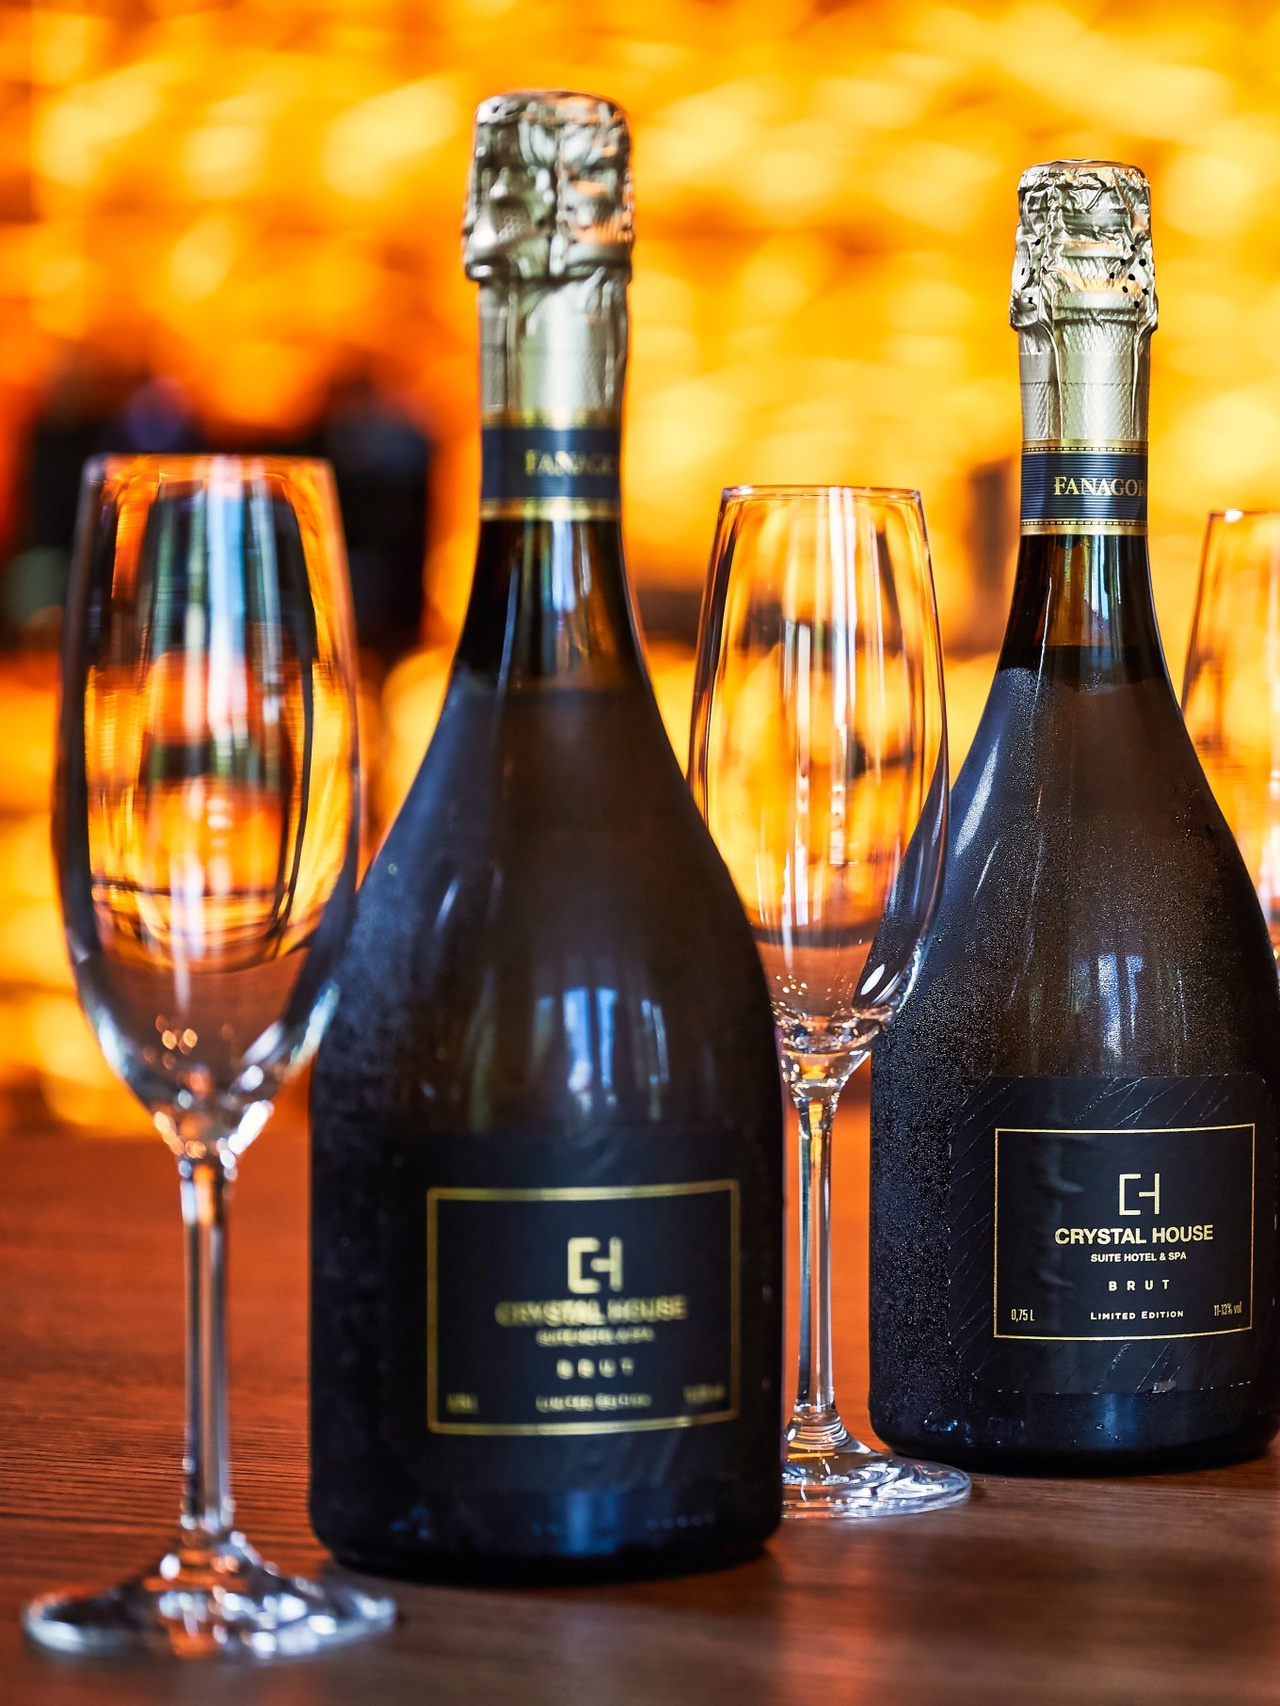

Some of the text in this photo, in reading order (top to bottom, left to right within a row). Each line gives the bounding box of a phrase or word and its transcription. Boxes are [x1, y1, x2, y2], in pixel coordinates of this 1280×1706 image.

[1119, 1173, 1160, 1216] CH
[1054, 1224, 1214, 1245] CRYSTAL HOUSE
[1090, 1251, 1187, 1263] SUITE HOTEL & SPA
[1108, 1279, 1170, 1292] BRUT
[1011, 1308, 1035, 1323] 0,75 L
[1090, 1310, 1184, 1320] LIMITED EDITION
